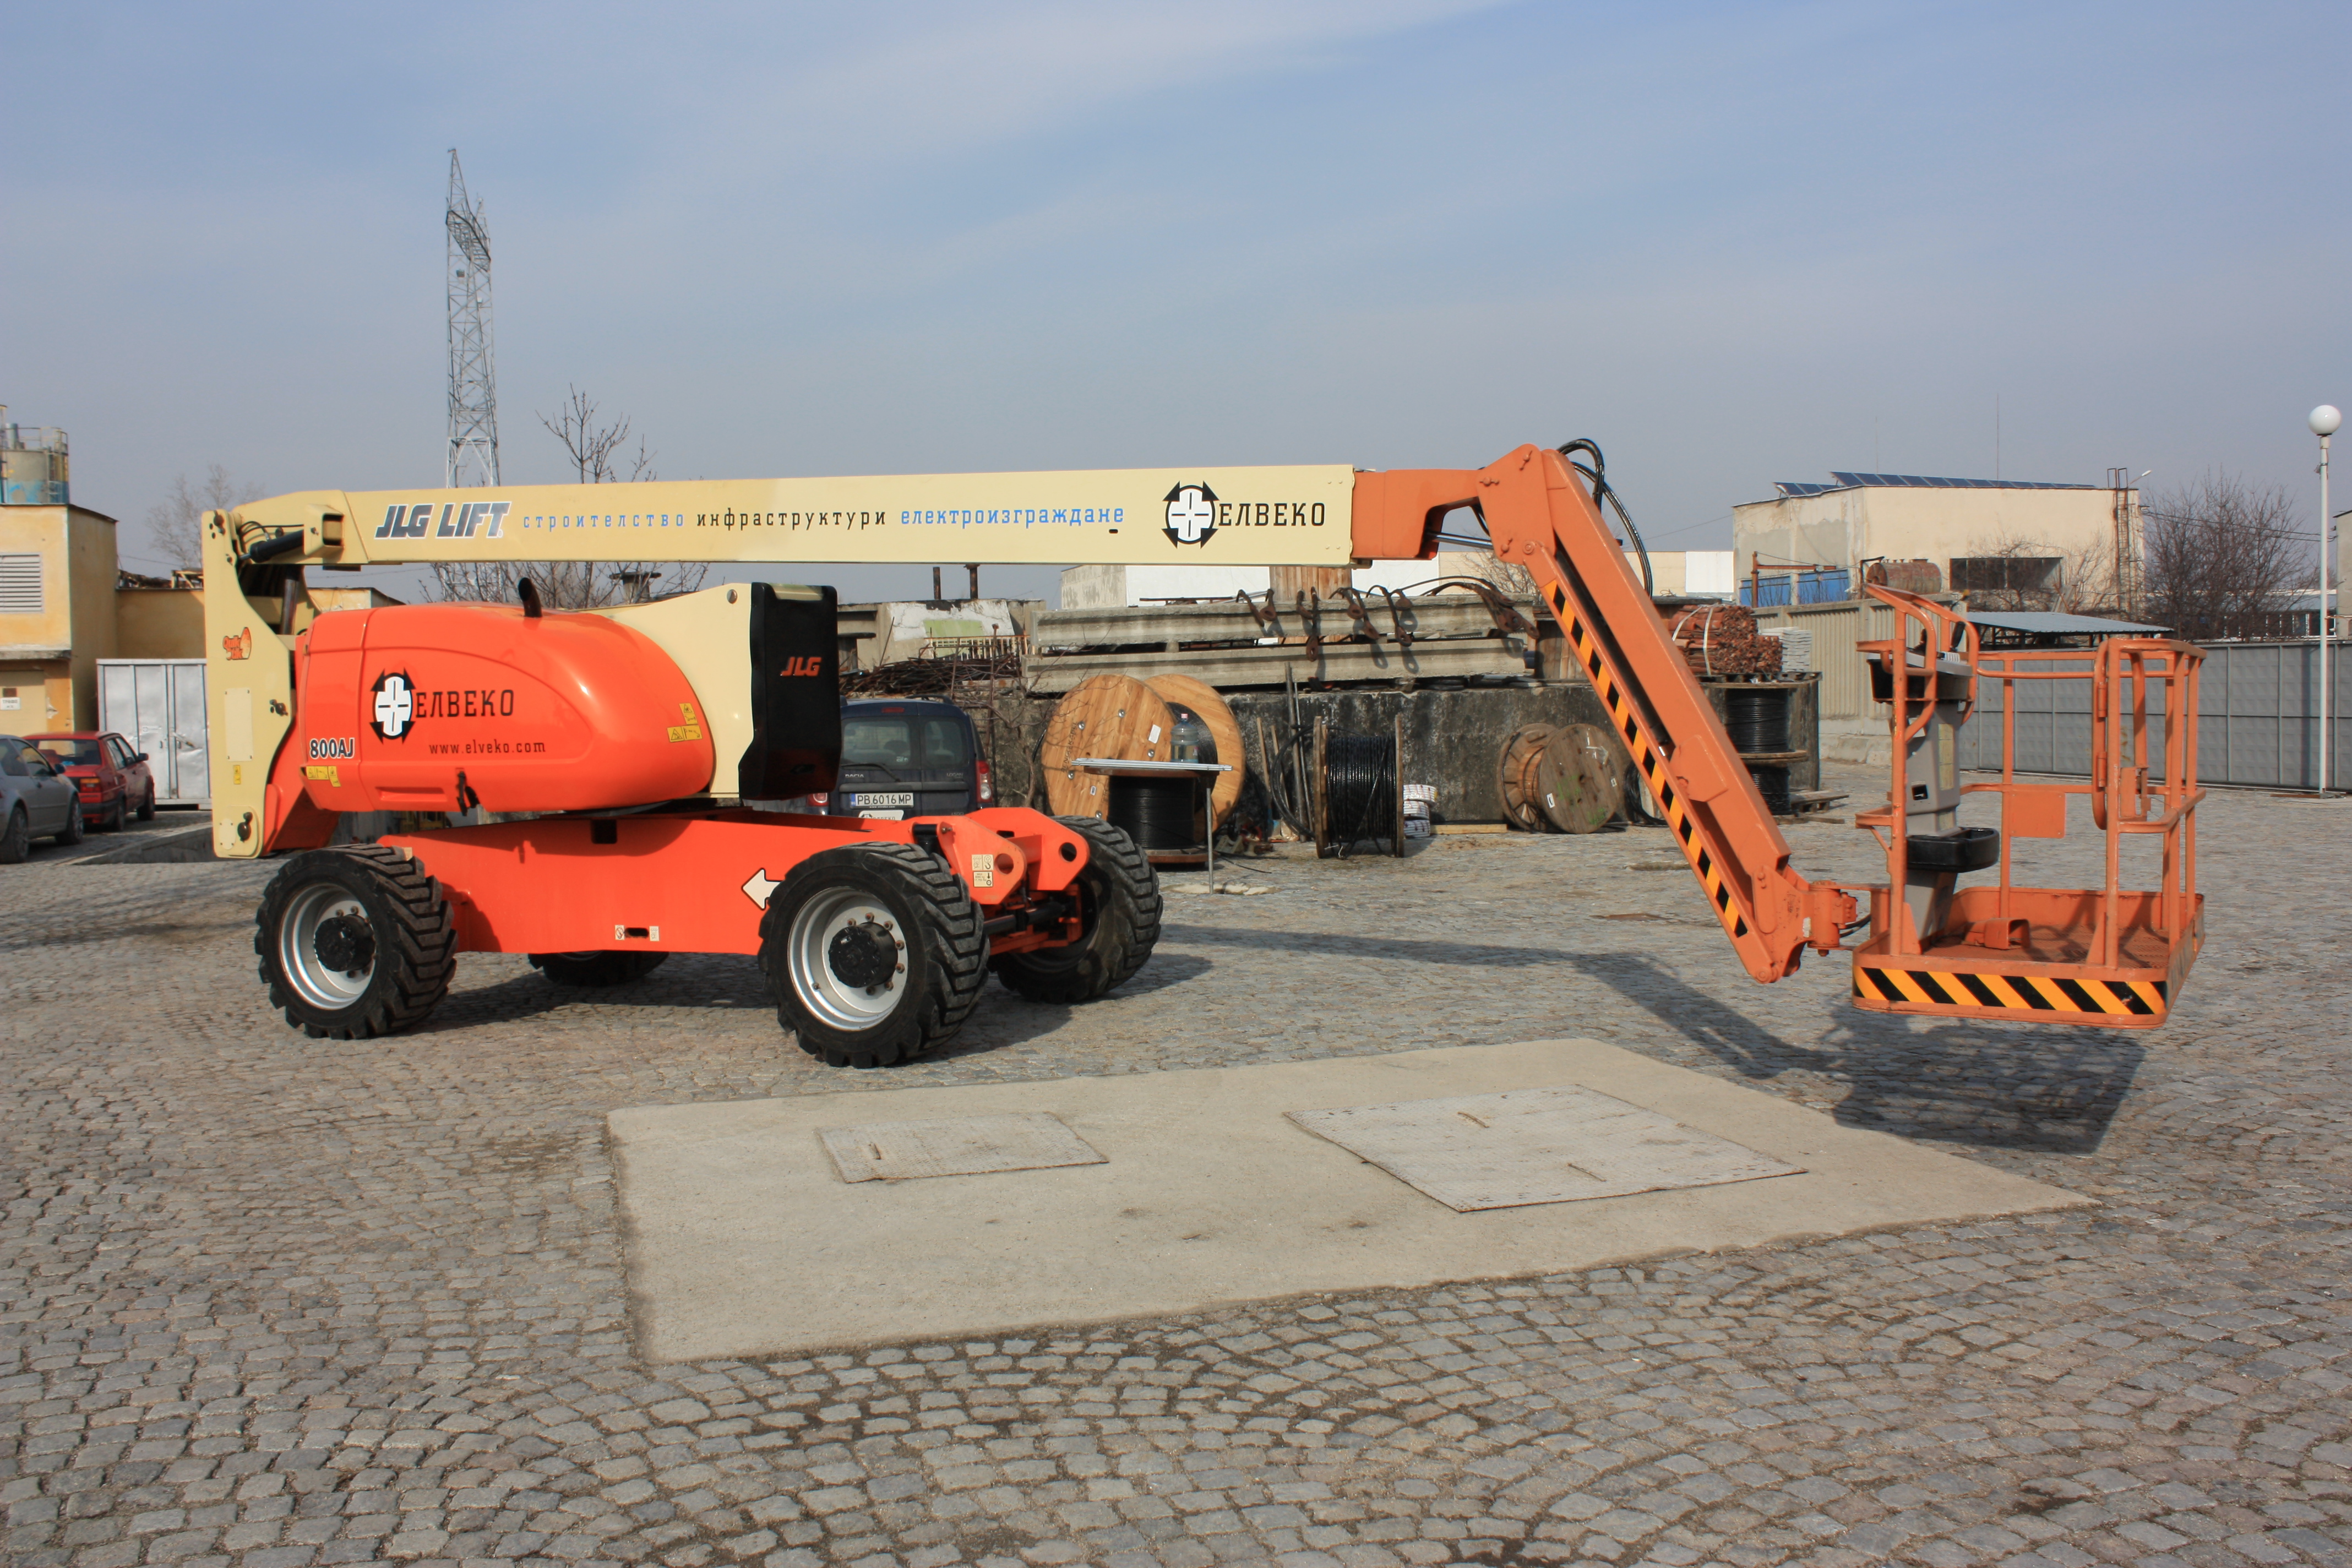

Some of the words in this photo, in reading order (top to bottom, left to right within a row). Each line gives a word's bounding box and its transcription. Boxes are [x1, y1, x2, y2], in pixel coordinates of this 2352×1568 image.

[374, 503, 434, 540] JLG
[435, 501, 512, 539] LIFT
[524, 513, 683, 531] строителство
[697, 507, 886, 531] инфраструктури
[901, 507, 1124, 530] електроизграждане
[1218, 502, 1325, 527] ЕЛВЕКО
[780, 656, 823, 677] JLG
[416, 689, 514, 718] ЕЛВЕКО
[309, 737, 355, 760] 800AJ
[429, 739, 546, 754] www.elveko.com
[857, 795, 870, 805] PB
[872, 794, 897, 805] 6016
[899, 794, 912, 804] MP
